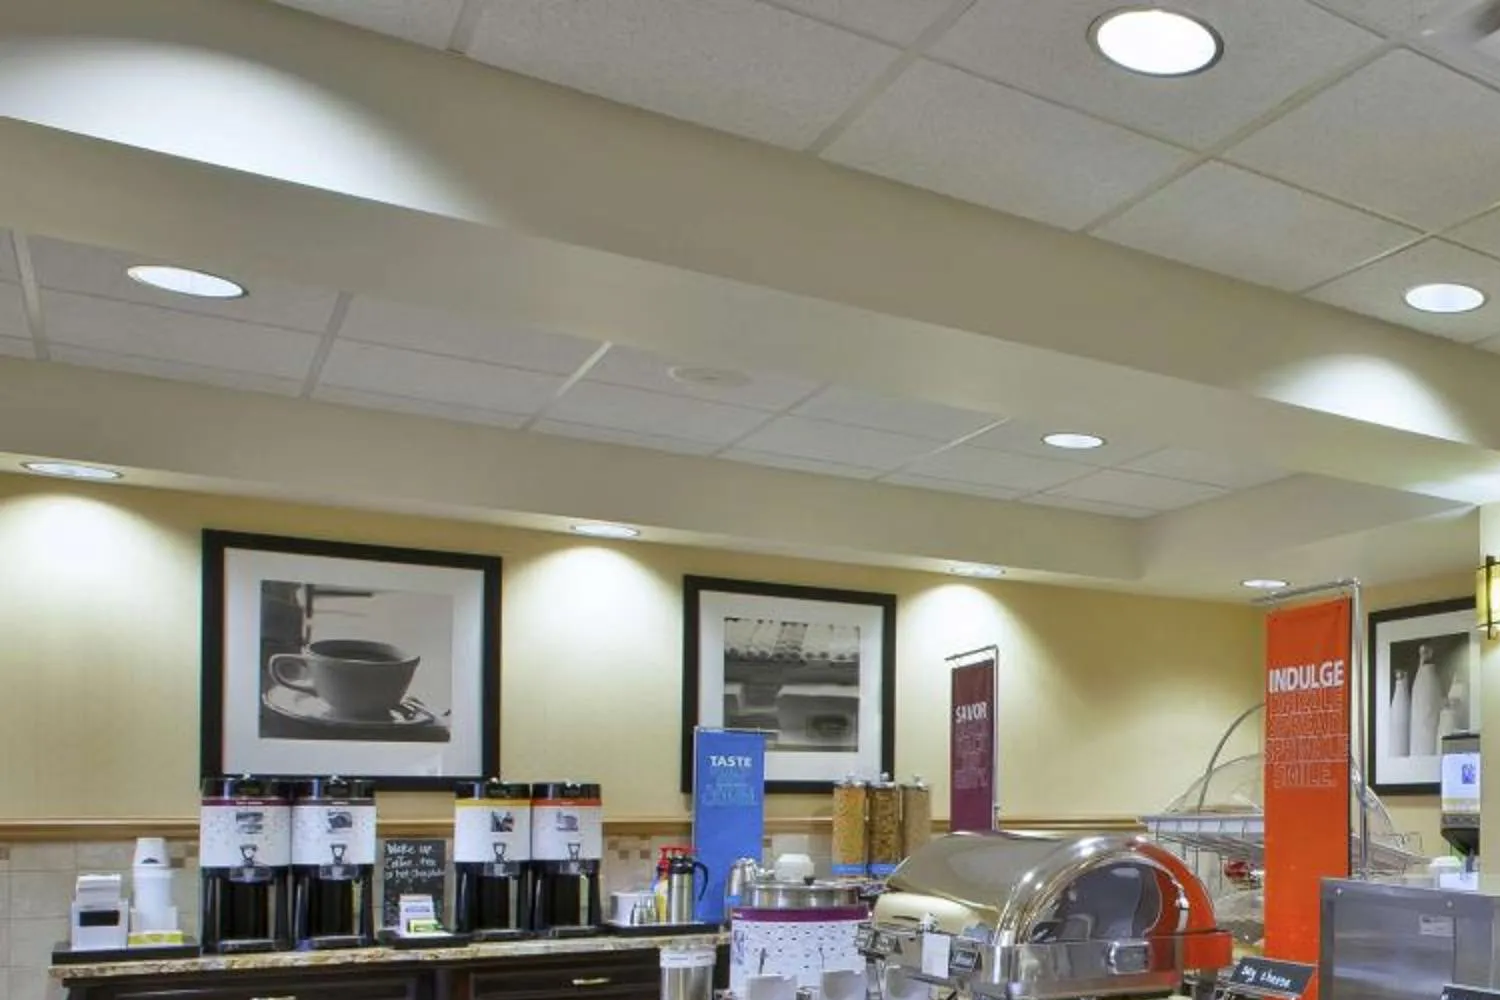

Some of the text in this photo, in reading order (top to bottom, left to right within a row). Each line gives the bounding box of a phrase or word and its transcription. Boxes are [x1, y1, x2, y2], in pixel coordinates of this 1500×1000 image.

[1269, 660, 1345, 693] INDULGE
[955, 701, 988, 724] SAVOR
[710, 755, 752, 768] TASTE
